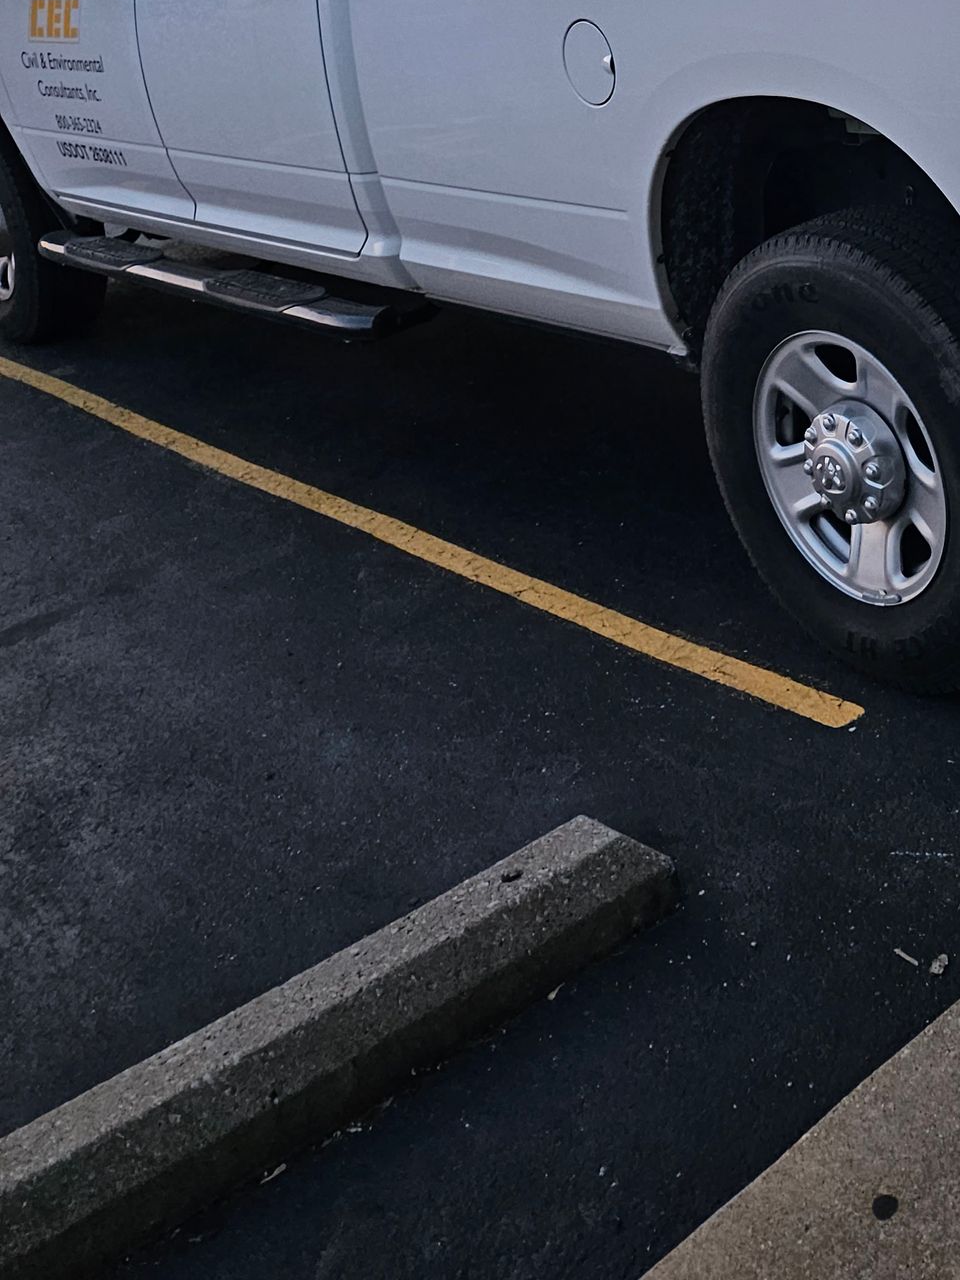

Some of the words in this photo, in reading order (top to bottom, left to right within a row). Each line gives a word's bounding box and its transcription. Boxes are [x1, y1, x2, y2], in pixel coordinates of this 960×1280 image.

[21, 51, 38, 69] Civil
[39, 52, 47, 68] &
[47, 52, 105, 73] Environmental
[37, 80, 86, 102] Consultants,
[86, 83, 102, 102] Inc.
[56, 140, 90, 161] USDOT
